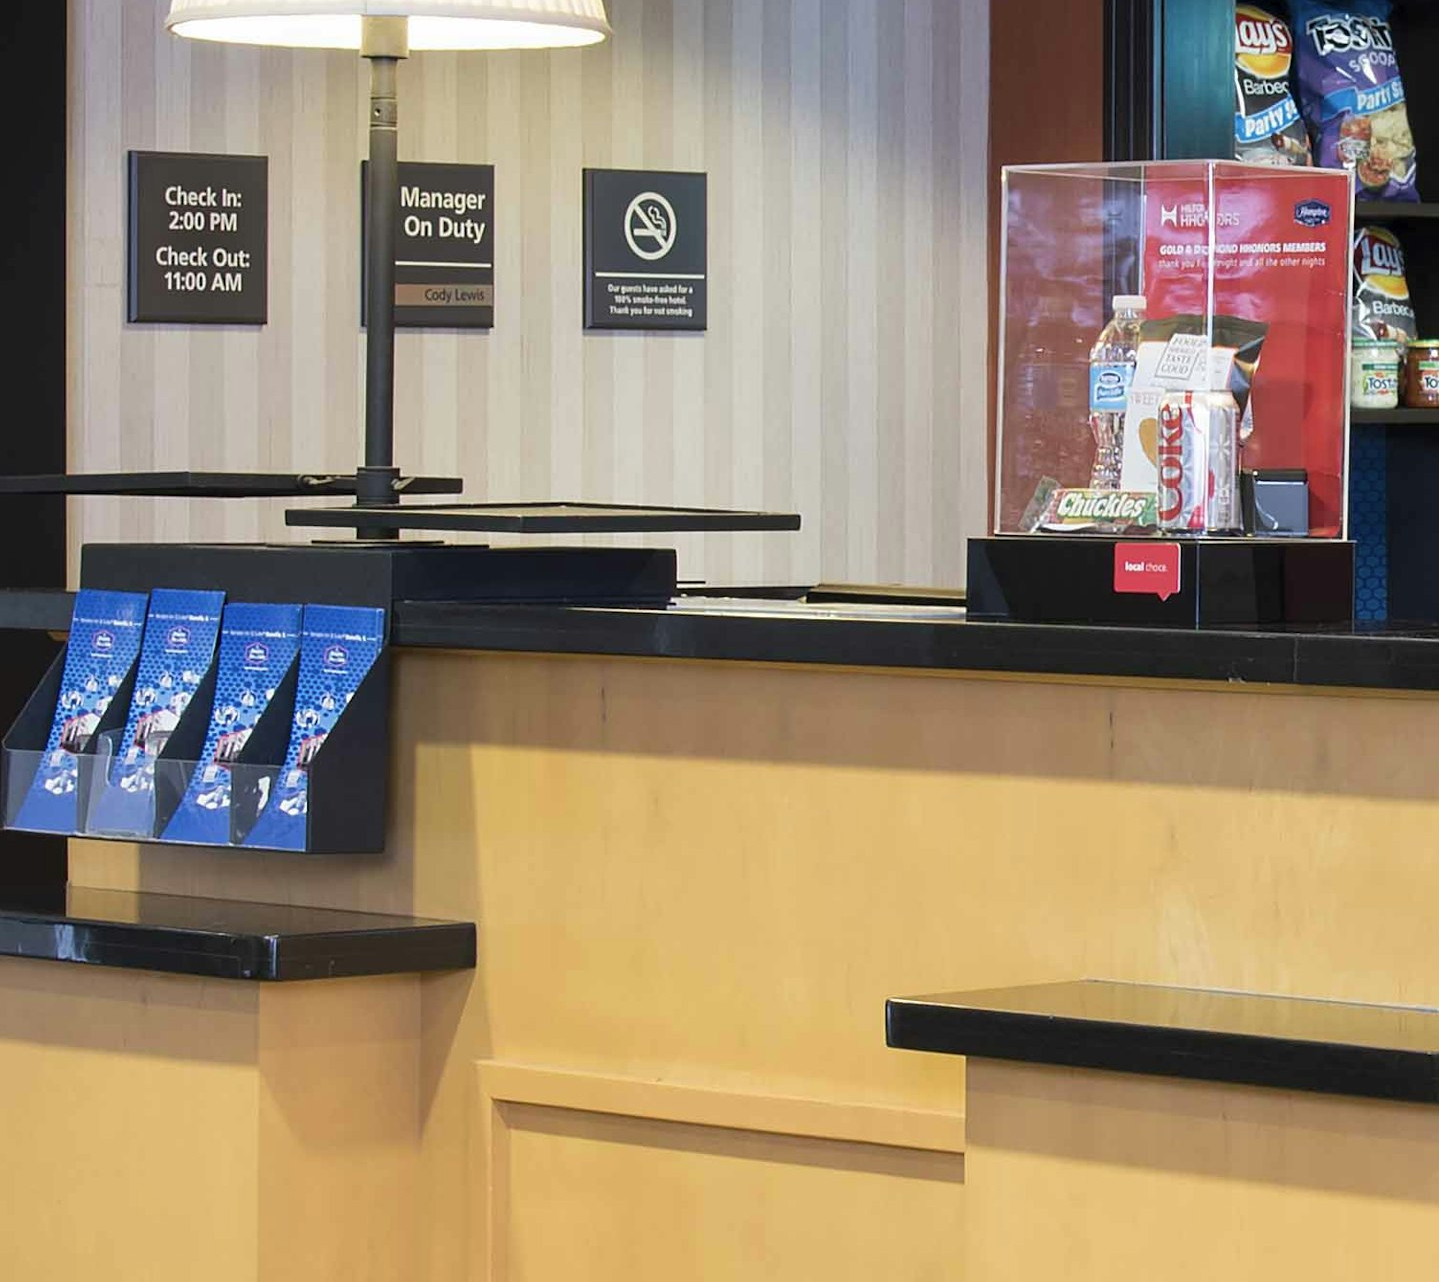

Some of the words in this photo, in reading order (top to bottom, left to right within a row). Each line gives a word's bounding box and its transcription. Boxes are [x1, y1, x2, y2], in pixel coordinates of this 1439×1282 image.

[1357, 86, 1391, 111] Party
[1245, 106, 1284, 138] Party
[165, 185, 218, 207] Check
[222, 188, 242, 208] In:
[400, 186, 486, 215] Manager
[1181, 204, 1207, 213] HILTO
[168, 211, 205, 231] 2:00
[210, 212, 238, 232] PM
[1181, 213, 1240, 226] HHOORS
[404, 215, 432, 237] On
[439, 216, 486, 244] Duty
[156, 245, 208, 267] Check
[213, 248, 250, 268] Out:
[1160, 244, 1184, 255] GOLD
[1240, 243, 1281, 254] HHONORS
[1283, 242, 1326, 253] MEMBERS
[1265, 257, 1278, 267] the
[1280, 257, 1300, 266] other
[1302, 257, 1325, 269] nights
[164, 271, 207, 291] 11:00
[211, 272, 242, 292] AM
[607, 284, 620, 293] Our
[621, 285, 641, 294] guests
[642, 284, 658, 293] have
[659, 284, 677, 293] asked
[678, 284, 688, 294] for
[424, 288, 452, 303] Cody
[455, 288, 485, 301] Lewis
[614, 295, 631, 304] 100%
[632, 295, 667, 304] smoke-free
[610, 305, 629, 314] Thank
[630, 307, 642, 317] you
[643, 306, 653, 315] for
[654, 307, 665, 315] not
[666, 307, 693, 317] smoking
[1056, 491, 1147, 519] Chuckles
[1124, 560, 1145, 572] local
